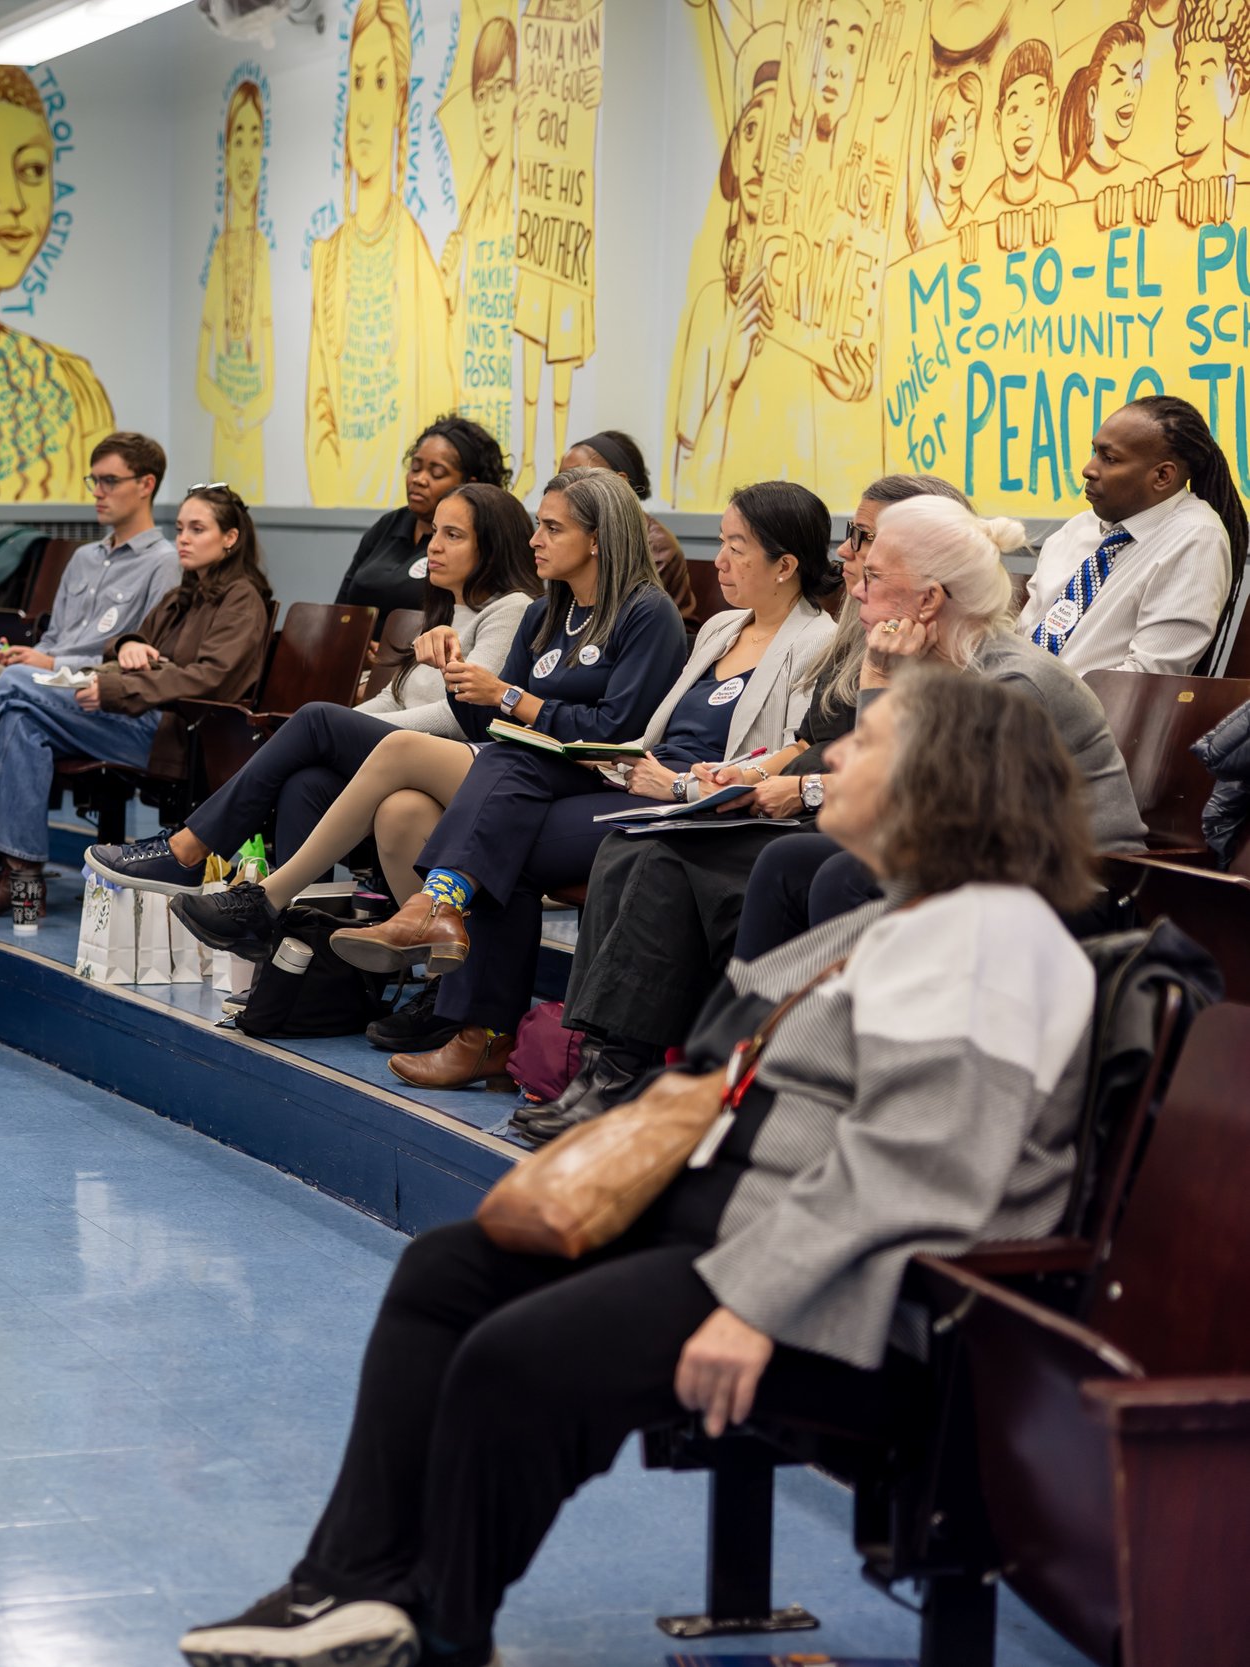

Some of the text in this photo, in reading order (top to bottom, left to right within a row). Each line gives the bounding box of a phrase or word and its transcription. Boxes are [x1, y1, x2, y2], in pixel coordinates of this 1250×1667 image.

[524, 9, 600, 71] CAN A MAN
[537, 105, 570, 150] and
[520, 159, 587, 207] HATE HIS
[1, 180, 76, 319] ACTIVIST
[516, 208, 594, 287] BROTHER?
[908, 261, 983, 335] MS
[955, 306, 1165, 359] COMMUNITY
[886, 315, 952, 428] united
[906, 412, 948, 473] for
[1057, 606, 1072, 618] Math
